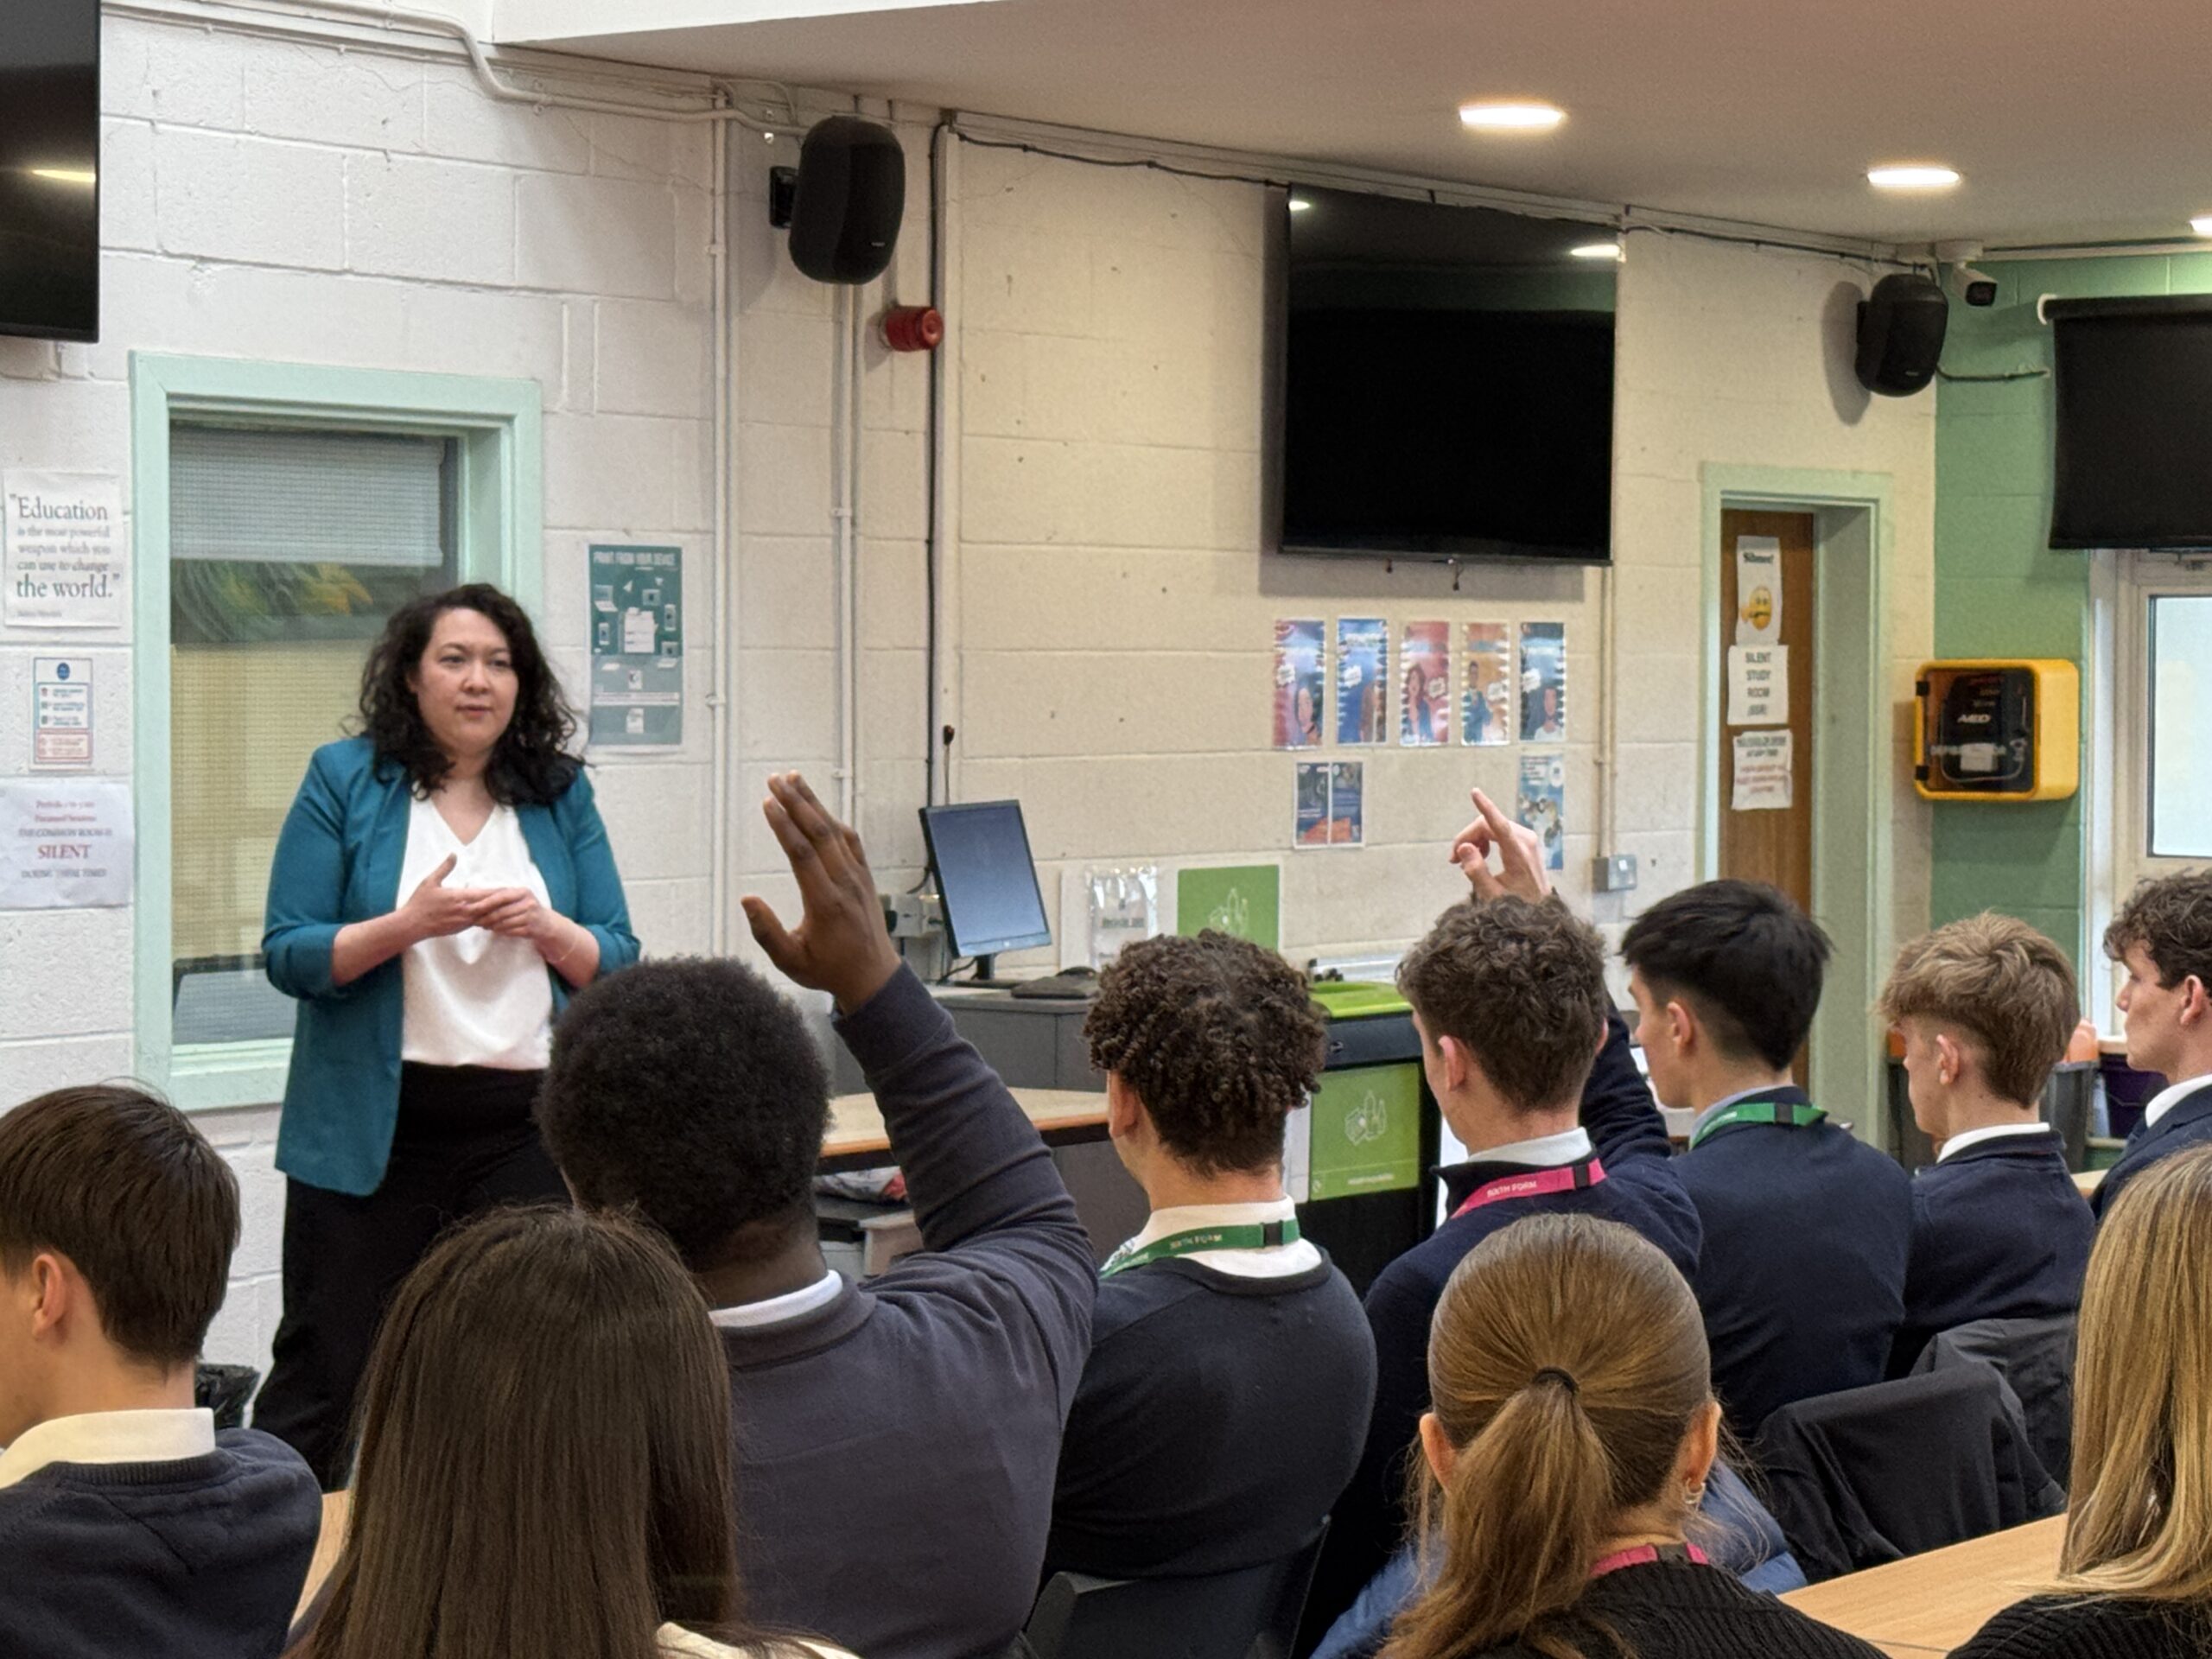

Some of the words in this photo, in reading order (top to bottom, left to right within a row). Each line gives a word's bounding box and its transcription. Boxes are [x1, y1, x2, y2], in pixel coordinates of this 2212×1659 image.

[16, 573, 48, 598] the
[37, 843, 92, 859] SILENT
[1487, 1185, 1510, 1198] SIXTH
[1511, 1180, 1537, 1192] FORM
